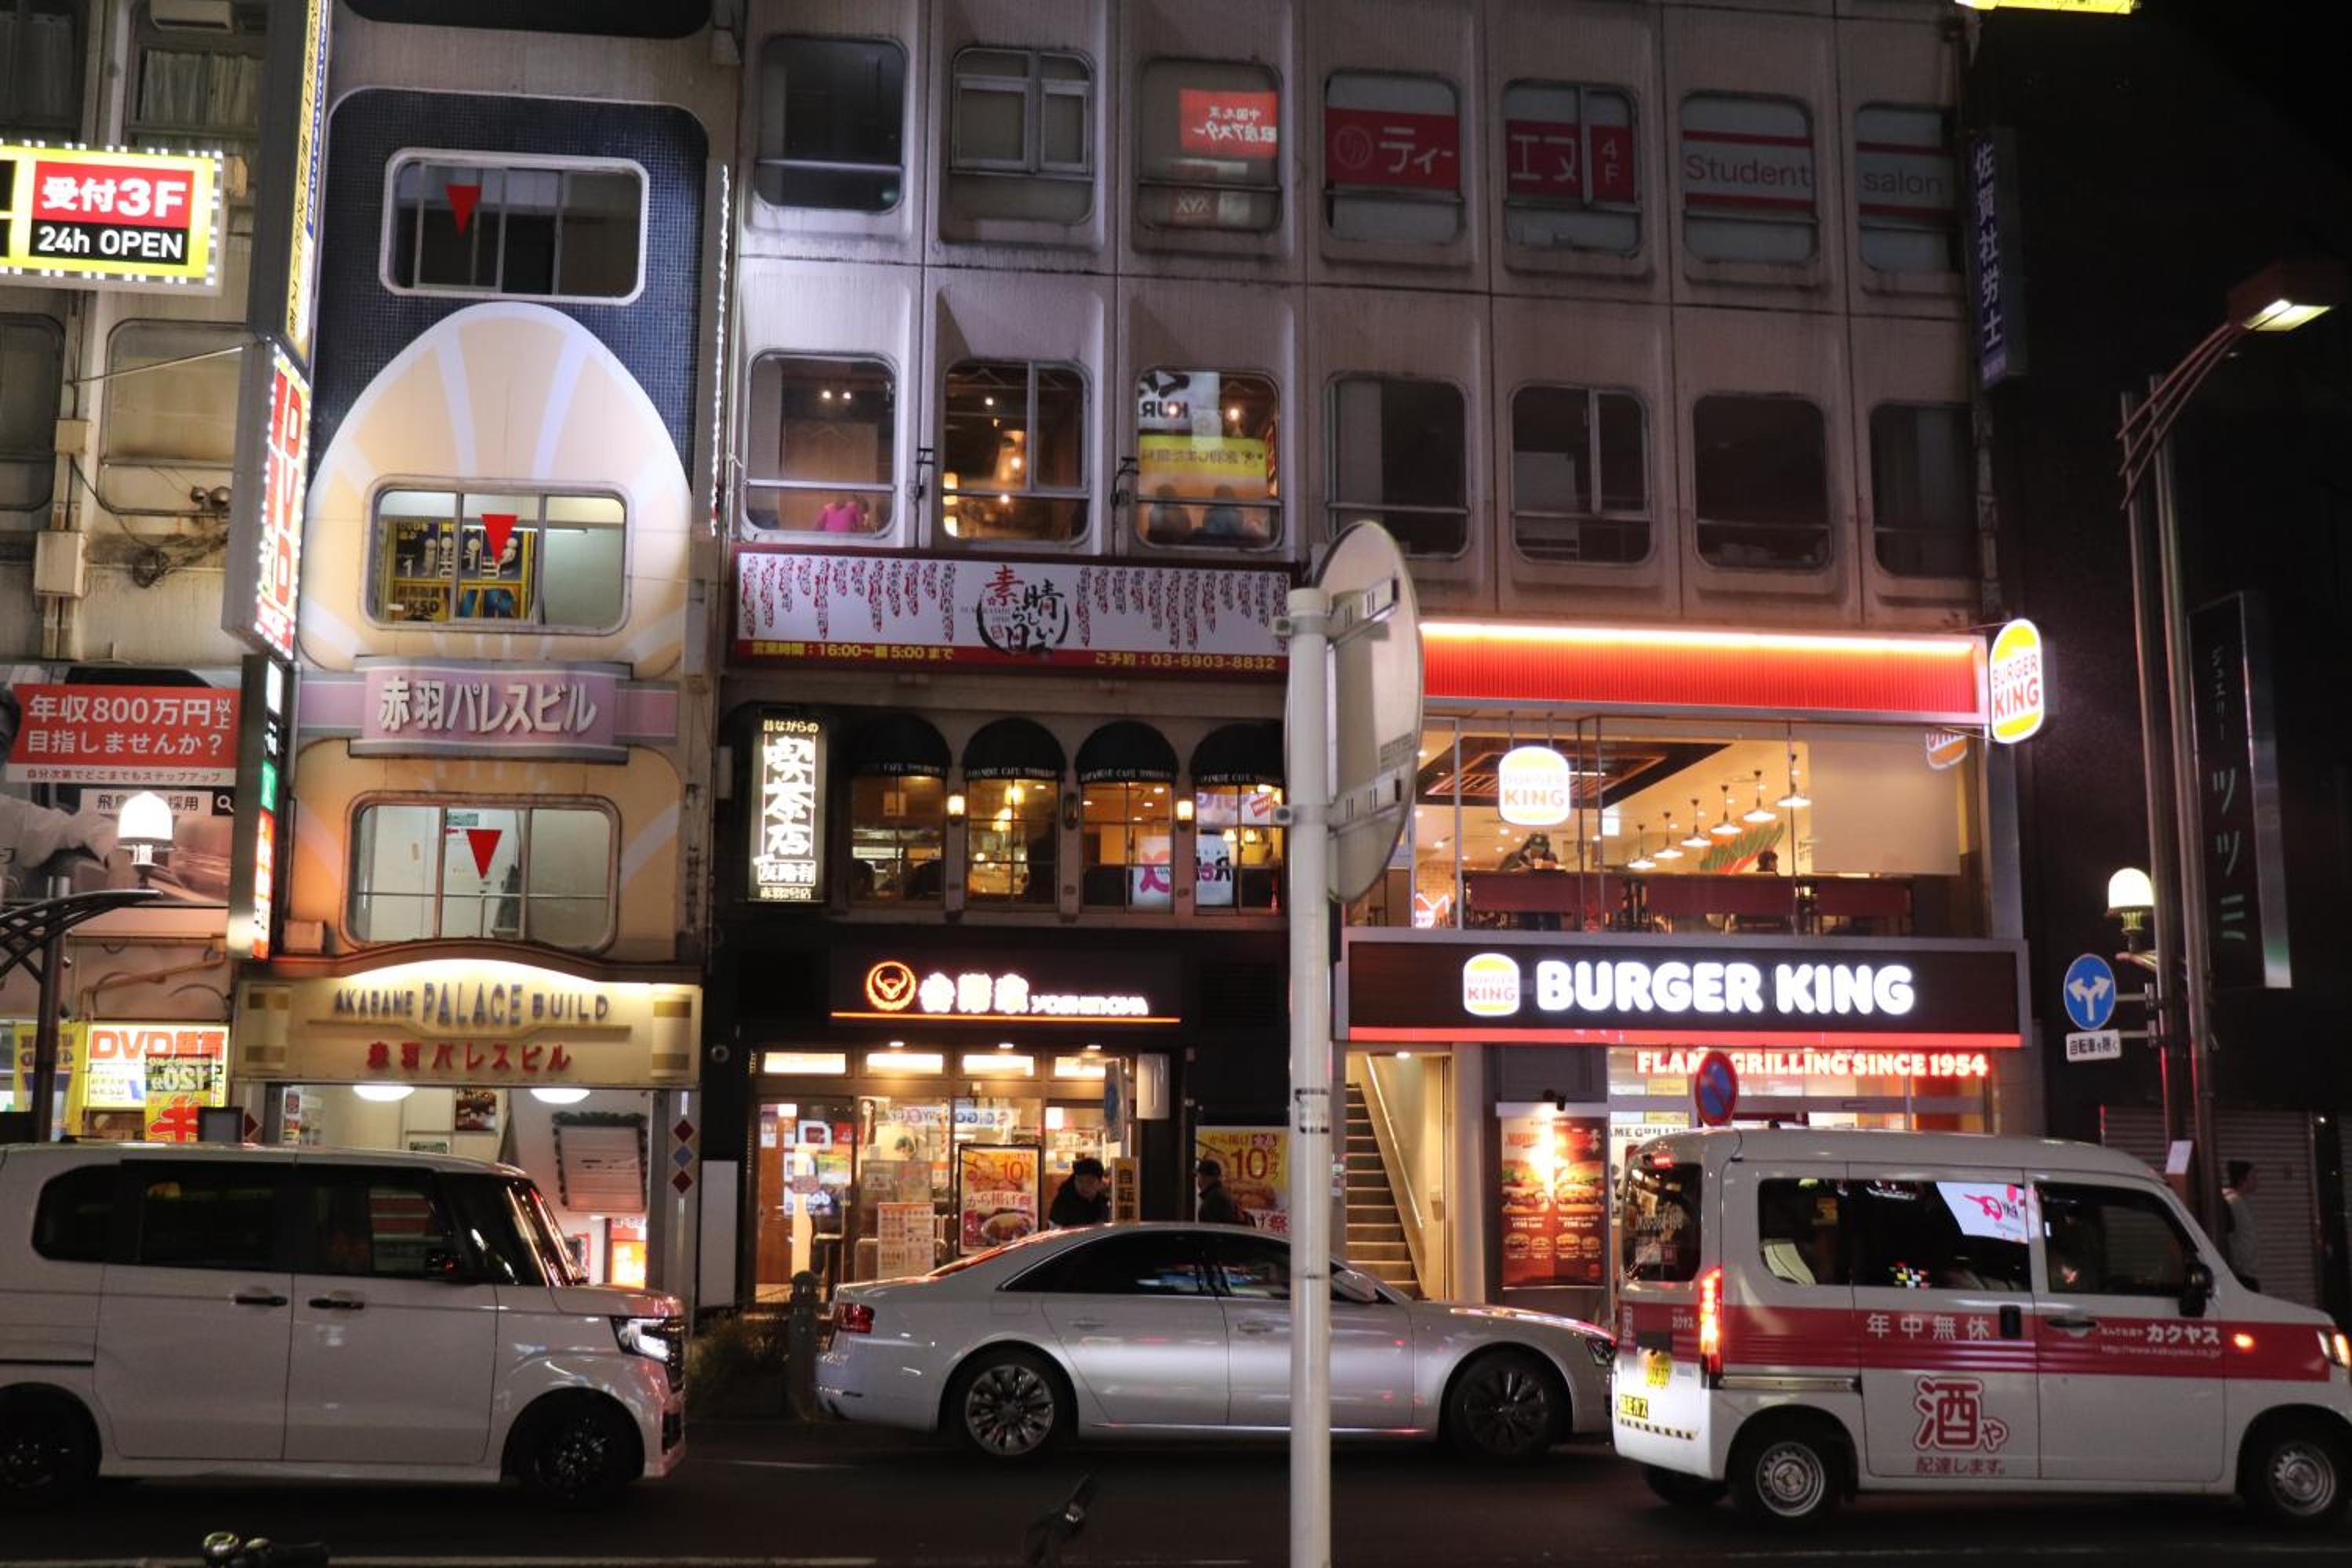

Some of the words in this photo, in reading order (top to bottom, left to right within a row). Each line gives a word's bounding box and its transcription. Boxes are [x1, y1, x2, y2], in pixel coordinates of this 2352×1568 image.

[1686, 154, 1814, 188] Student
[1863, 168, 1944, 196] salon
[42, 176, 188, 220] 受付3F
[38, 225, 91, 255] 24h
[100, 229, 183, 260] OPEN
[1992, 653, 2038, 688] BURGER
[29, 695, 212, 728] 年収800万円
[376, 676, 597, 734] 赤羽パレスビル
[1994, 678, 2039, 719] KING
[763, 720, 818, 733] 昔ながらの
[1504, 789, 1565, 807] KING
[334, 989, 414, 1017] AKABANE
[422, 982, 524, 1026] PALACE
[531, 993, 609, 1021] BUILD
[1467, 986, 1516, 1002] KING
[1536, 960, 1763, 1014] BURGER
[1775, 964, 1915, 1015] KING
[366, 1040, 572, 1073] 赤羽パレスビル
[1851, 1053, 1926, 1076] SINCE
[1929, 1054, 1988, 1077] 1954
[1867, 1312, 1991, 1340] 年中無休
[2147, 1324, 2220, 1345] カクヤス
[1915, 1377, 2008, 1452] 酒や
